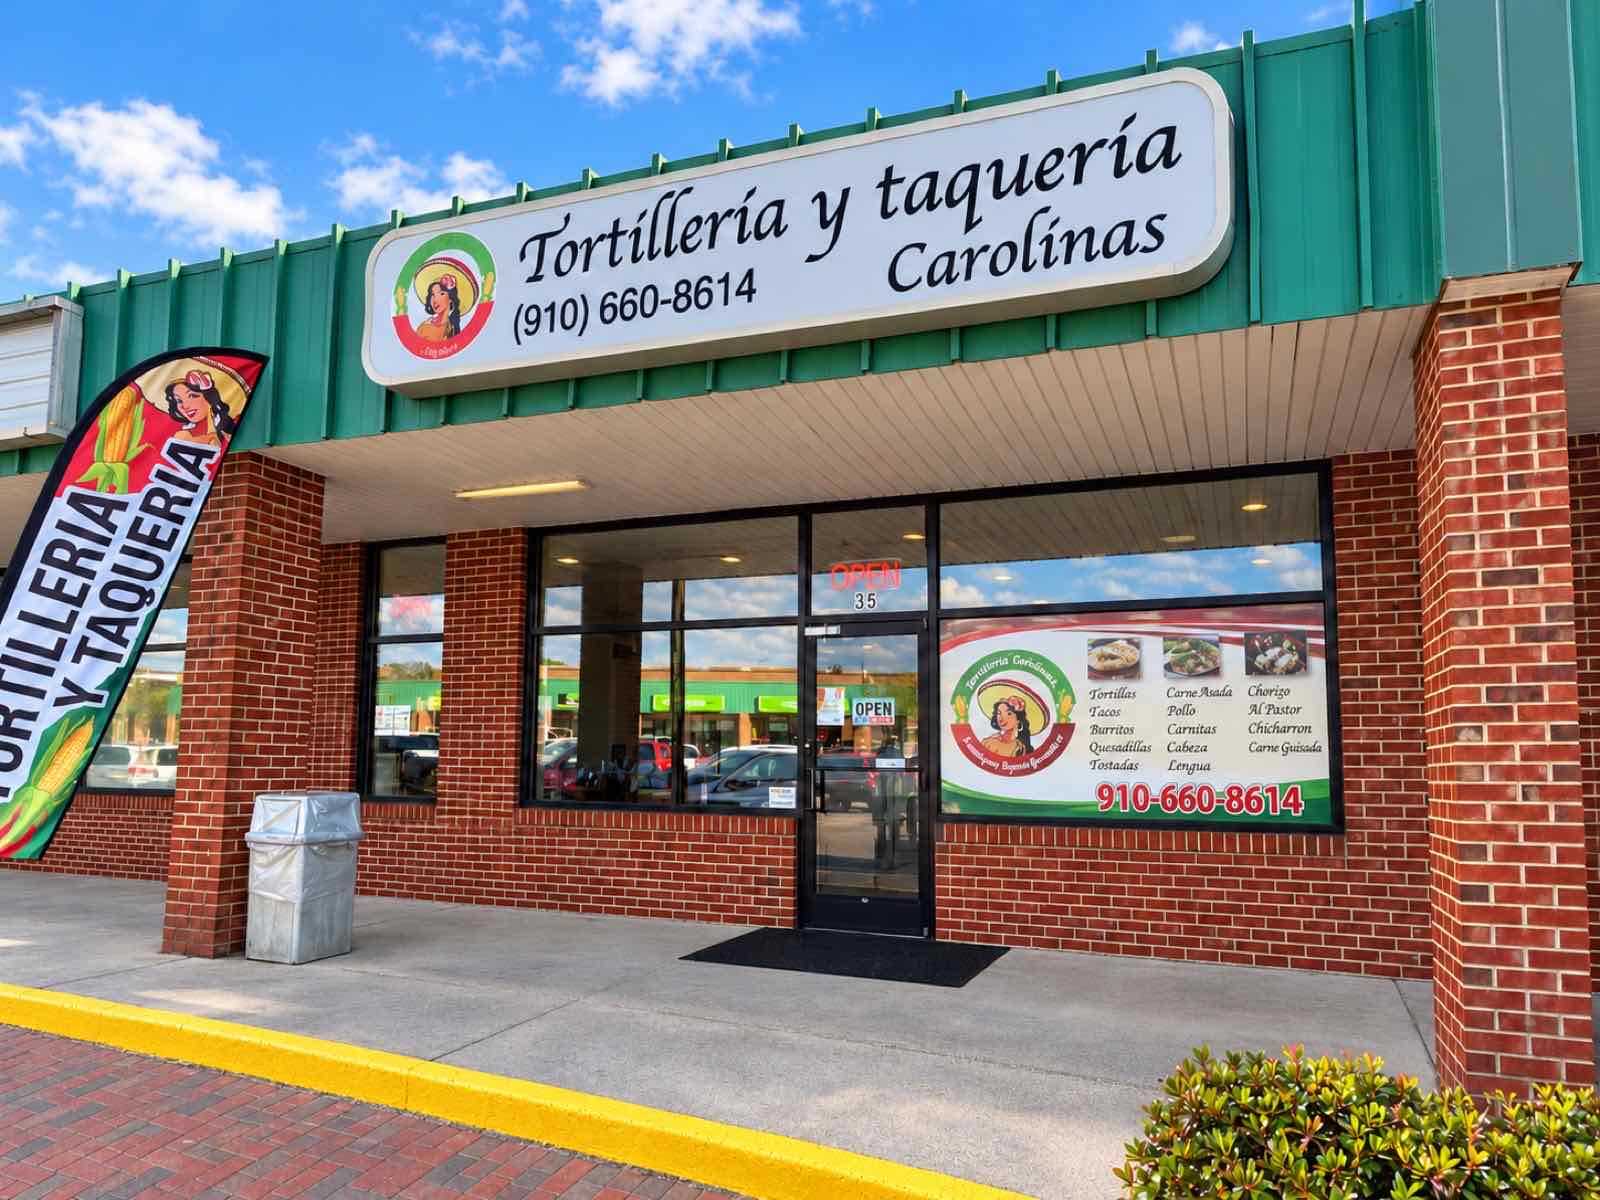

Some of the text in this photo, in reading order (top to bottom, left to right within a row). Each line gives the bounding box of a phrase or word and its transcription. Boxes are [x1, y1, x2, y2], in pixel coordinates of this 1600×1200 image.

[519, 112, 1182, 283] Tortillería y taquería
[888, 205, 1168, 293] Carolinas
[513, 268, 757, 345] (910) 660-8614
[53, 442, 217, 707] Y TAQUERIA
[832, 560, 900, 592] OPEN
[855, 593, 876, 609] 35
[0, 492, 129, 798] RTILLERIA
[1089, 686, 1137, 700] Tortillas
[1166, 684, 1233, 698] Carne Asada
[1248, 683, 1291, 699] Chorizo
[855, 702, 892, 716] OPEN
[1089, 706, 1121, 718] Tacos
[1167, 703, 1196, 717] Pollo
[1249, 703, 1302, 716] Al Pastor
[1089, 724, 1136, 736] Burritos
[1167, 722, 1217, 735] Carnitas
[1248, 721, 1312, 735] Chicharron
[1089, 740, 1152, 756] Quesadillas
[1166, 740, 1208, 753] Cabeza
[1248, 740, 1322, 756] Carne Guisada
[1090, 759, 1140, 771] Tostadas
[1168, 759, 1211, 775] Lengua
[1097, 783, 1304, 816] 910-660-8614
